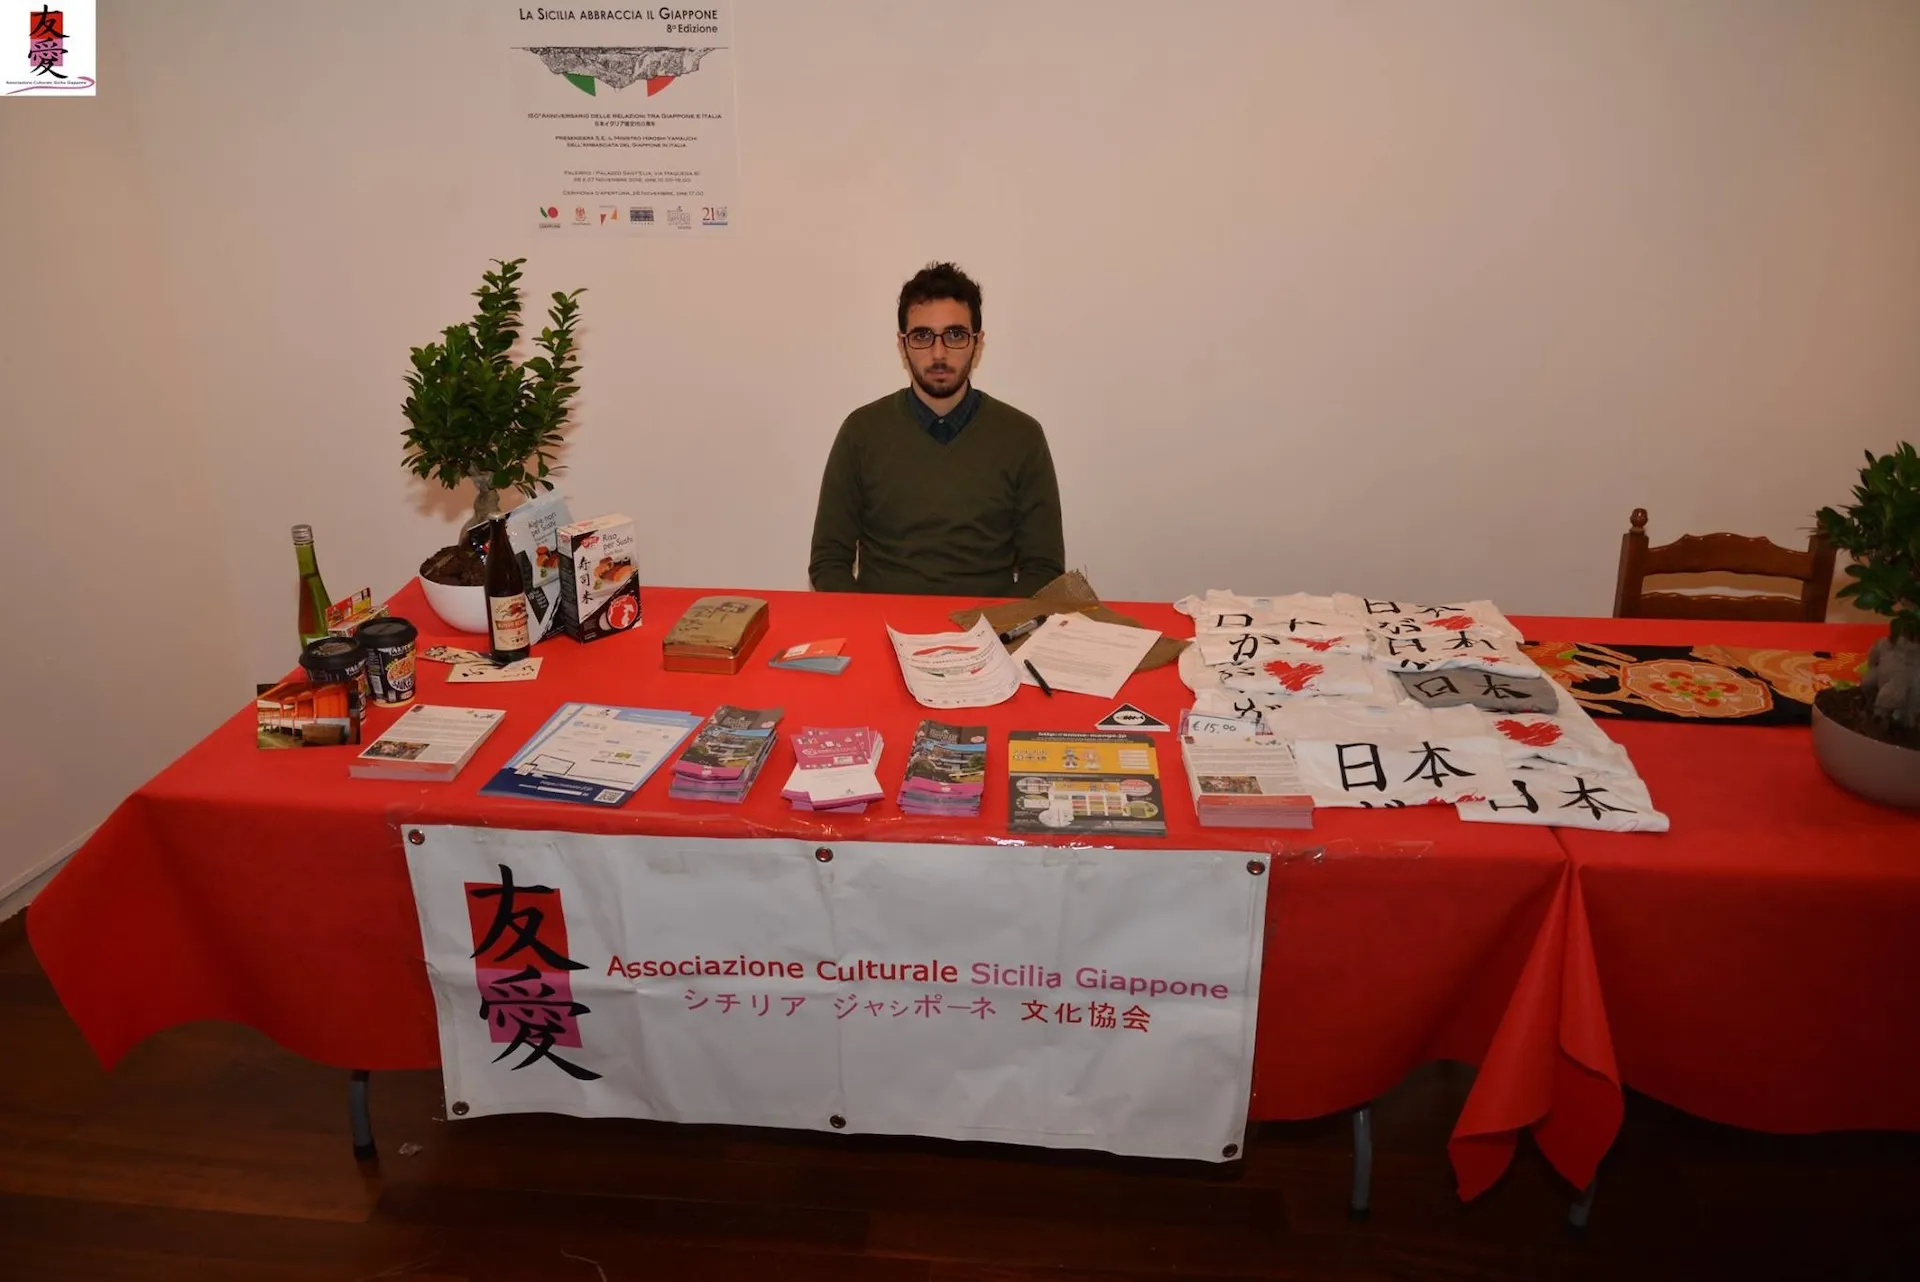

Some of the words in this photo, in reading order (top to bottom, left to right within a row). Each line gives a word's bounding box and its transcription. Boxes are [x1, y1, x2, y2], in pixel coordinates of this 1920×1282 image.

[519, 8, 533, 20] LA
[537, 8, 576, 20] SICILIA
[580, 10, 642, 20] ABBRACCIA
[646, 10, 655, 20] IL
[659, 7, 718, 20] GIAPPONE
[678, 24, 718, 33] Edizione
[602, 533, 617, 542] Riso
[603, 542, 615, 551] per
[616, 535, 634, 547] Sushi
[1335, 741, 1476, 792] 日本
[469, 864, 604, 1081] 友愛
[606, 954, 805, 980] Associazione
[816, 958, 958, 984] Culturale
[971, 962, 1062, 989] Sicilia
[1075, 967, 1229, 999] Giappone
[684, 989, 807, 1017] シチリア
[1020, 999, 1151, 1033] 文化協会
